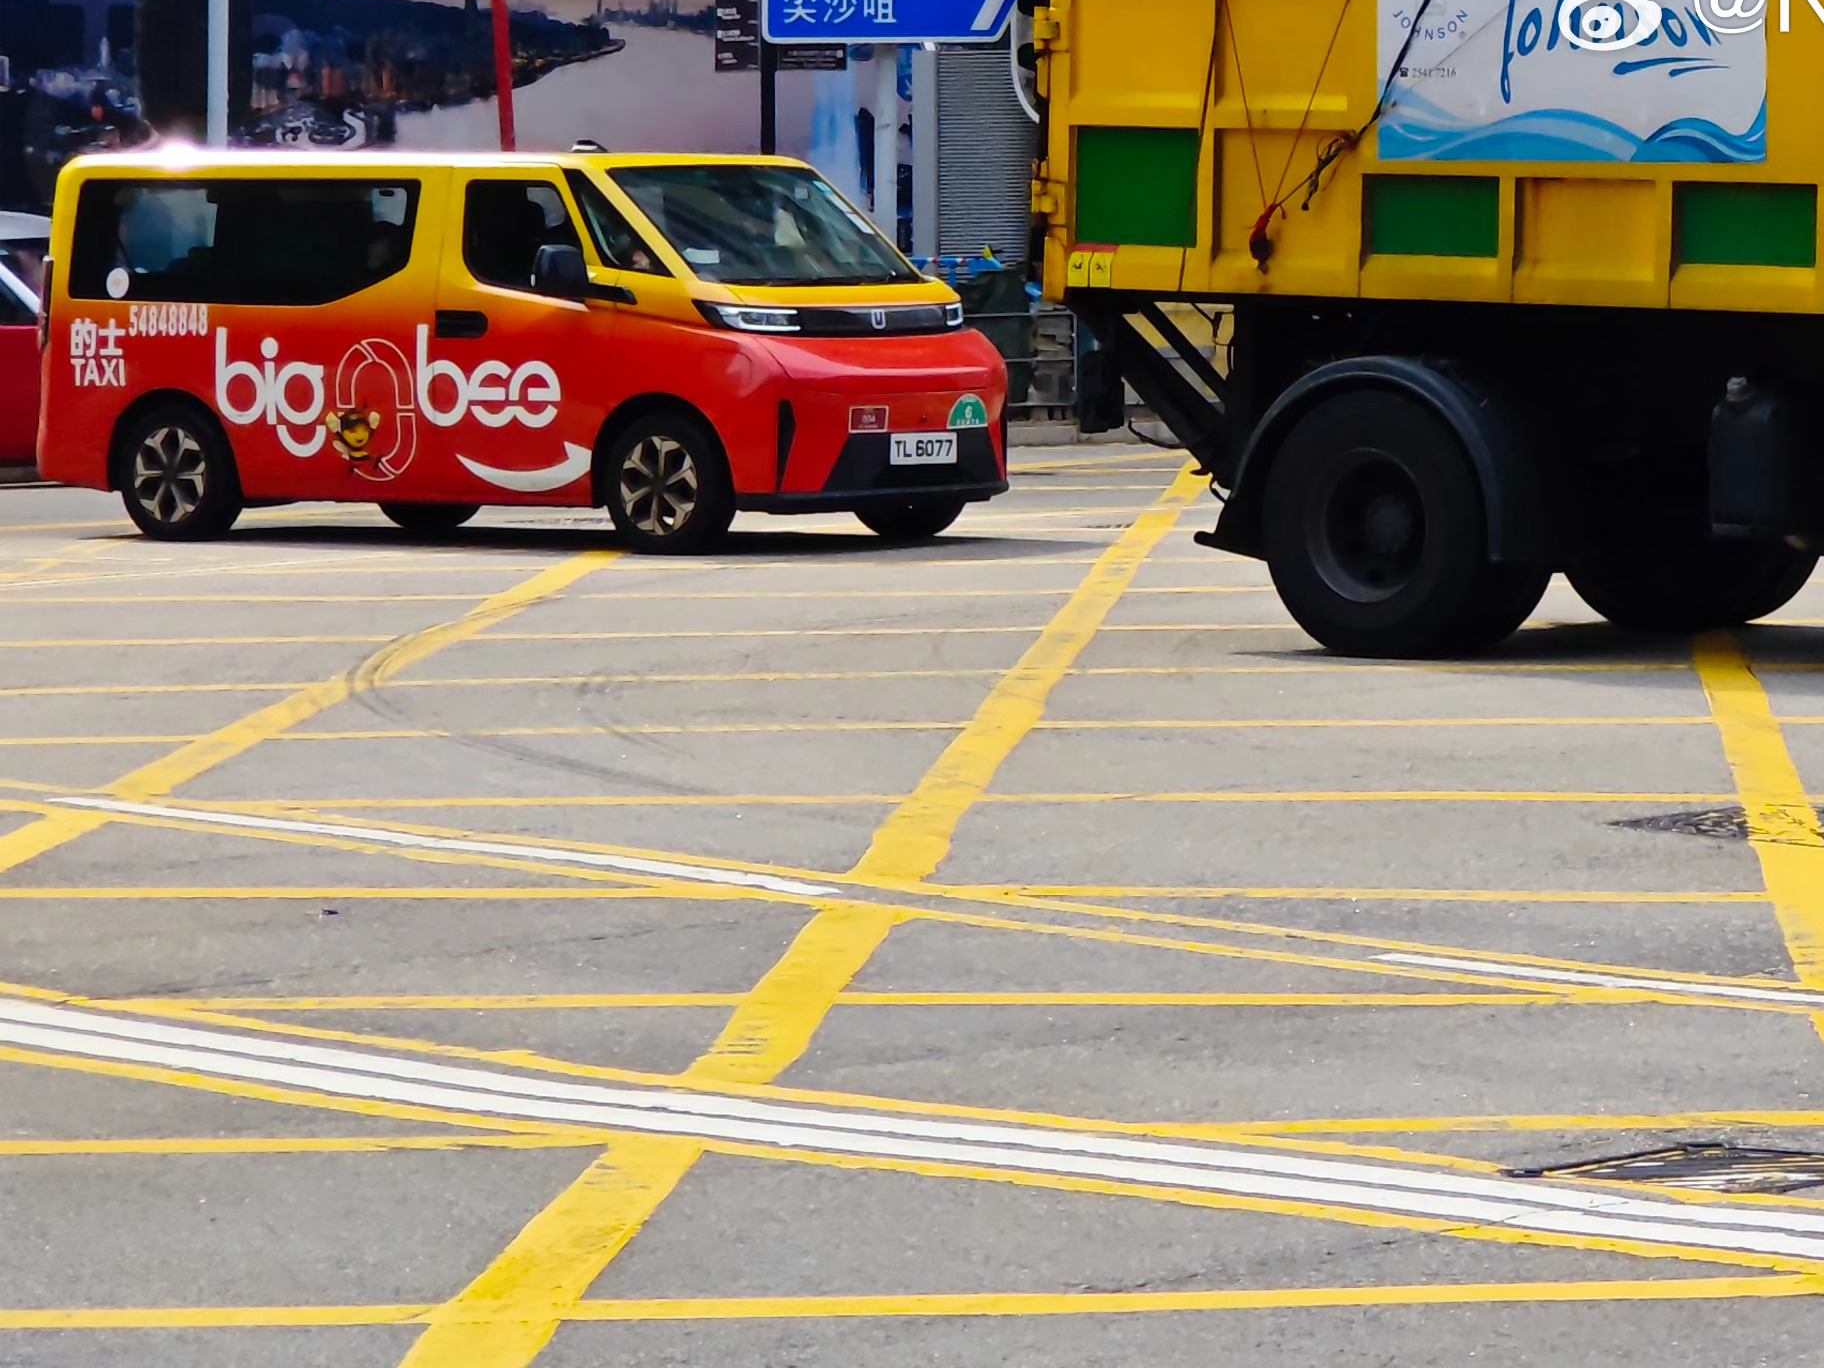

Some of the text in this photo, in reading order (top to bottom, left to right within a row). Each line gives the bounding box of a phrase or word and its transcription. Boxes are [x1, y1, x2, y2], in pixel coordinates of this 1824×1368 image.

[128, 304, 209, 337] 54848848
[70, 318, 126, 357] 的士
[70, 358, 127, 387] TAXI
[215, 323, 562, 458] big bee
[894, 439, 953, 458] TL 6077
